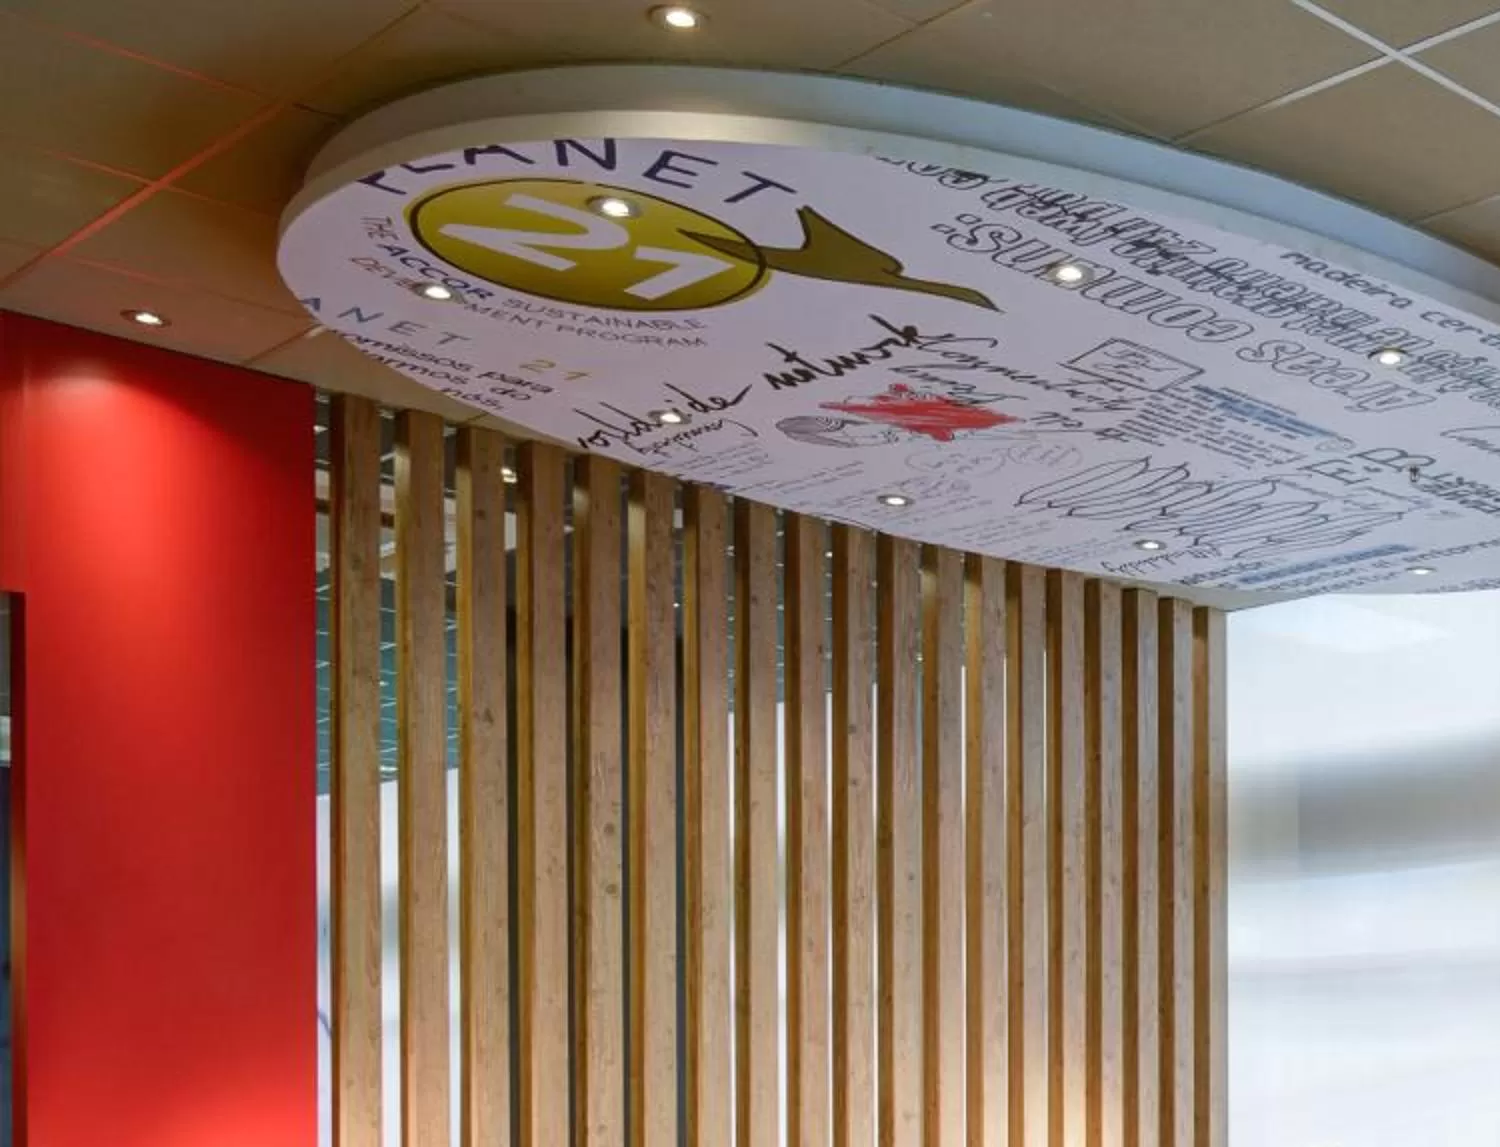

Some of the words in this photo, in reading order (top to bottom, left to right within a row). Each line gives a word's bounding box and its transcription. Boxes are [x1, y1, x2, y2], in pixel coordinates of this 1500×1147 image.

[438, 193, 735, 300] 21
[376, 243, 495, 300] ACCOR
[501, 298, 708, 331] SUSTAINABLE
[327, 328, 474, 373] omissos
[556, 322, 708, 347] PROGRAM
[360, 348, 471, 385] armos
[517, 358, 592, 381] 21
